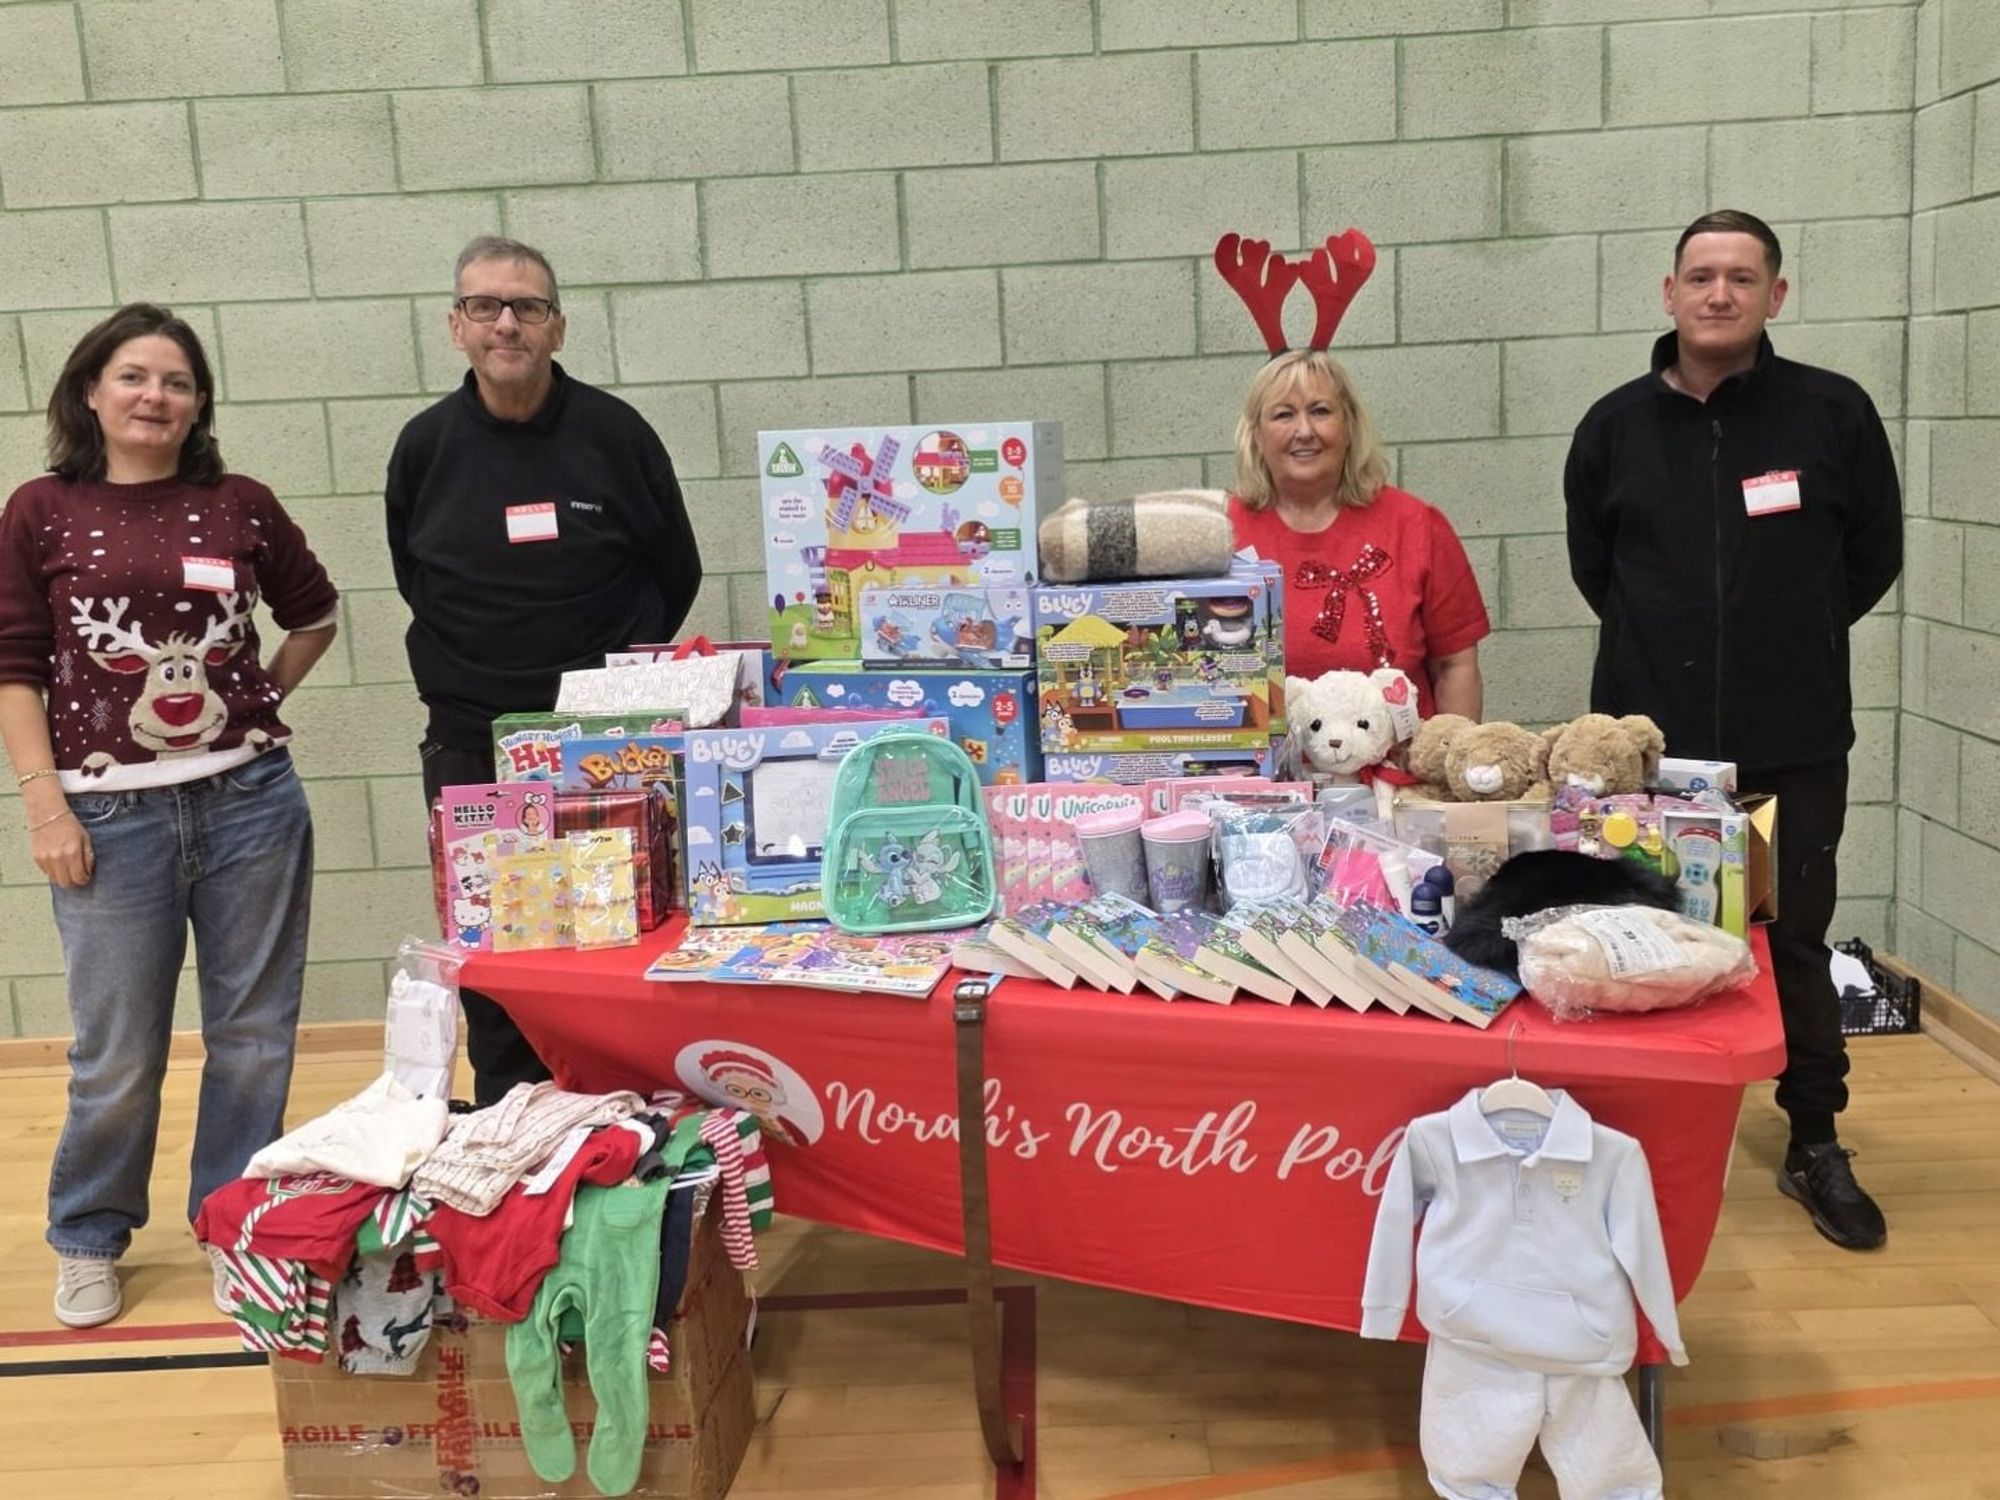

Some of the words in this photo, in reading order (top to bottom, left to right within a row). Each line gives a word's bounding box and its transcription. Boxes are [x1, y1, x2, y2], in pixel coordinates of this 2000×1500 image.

[995, 701, 1014, 711] 2-5
[510, 743, 563, 773] HIP
[454, 804, 495, 813] HELLO
[454, 813, 495, 823] KITTY
[790, 901, 823, 912] MAGN
[825, 1078, 1051, 1158] Norah's
[1065, 1100, 1258, 1176] North
[1277, 1122, 1406, 1197] Pol
[282, 1423, 364, 1443] AGILE
